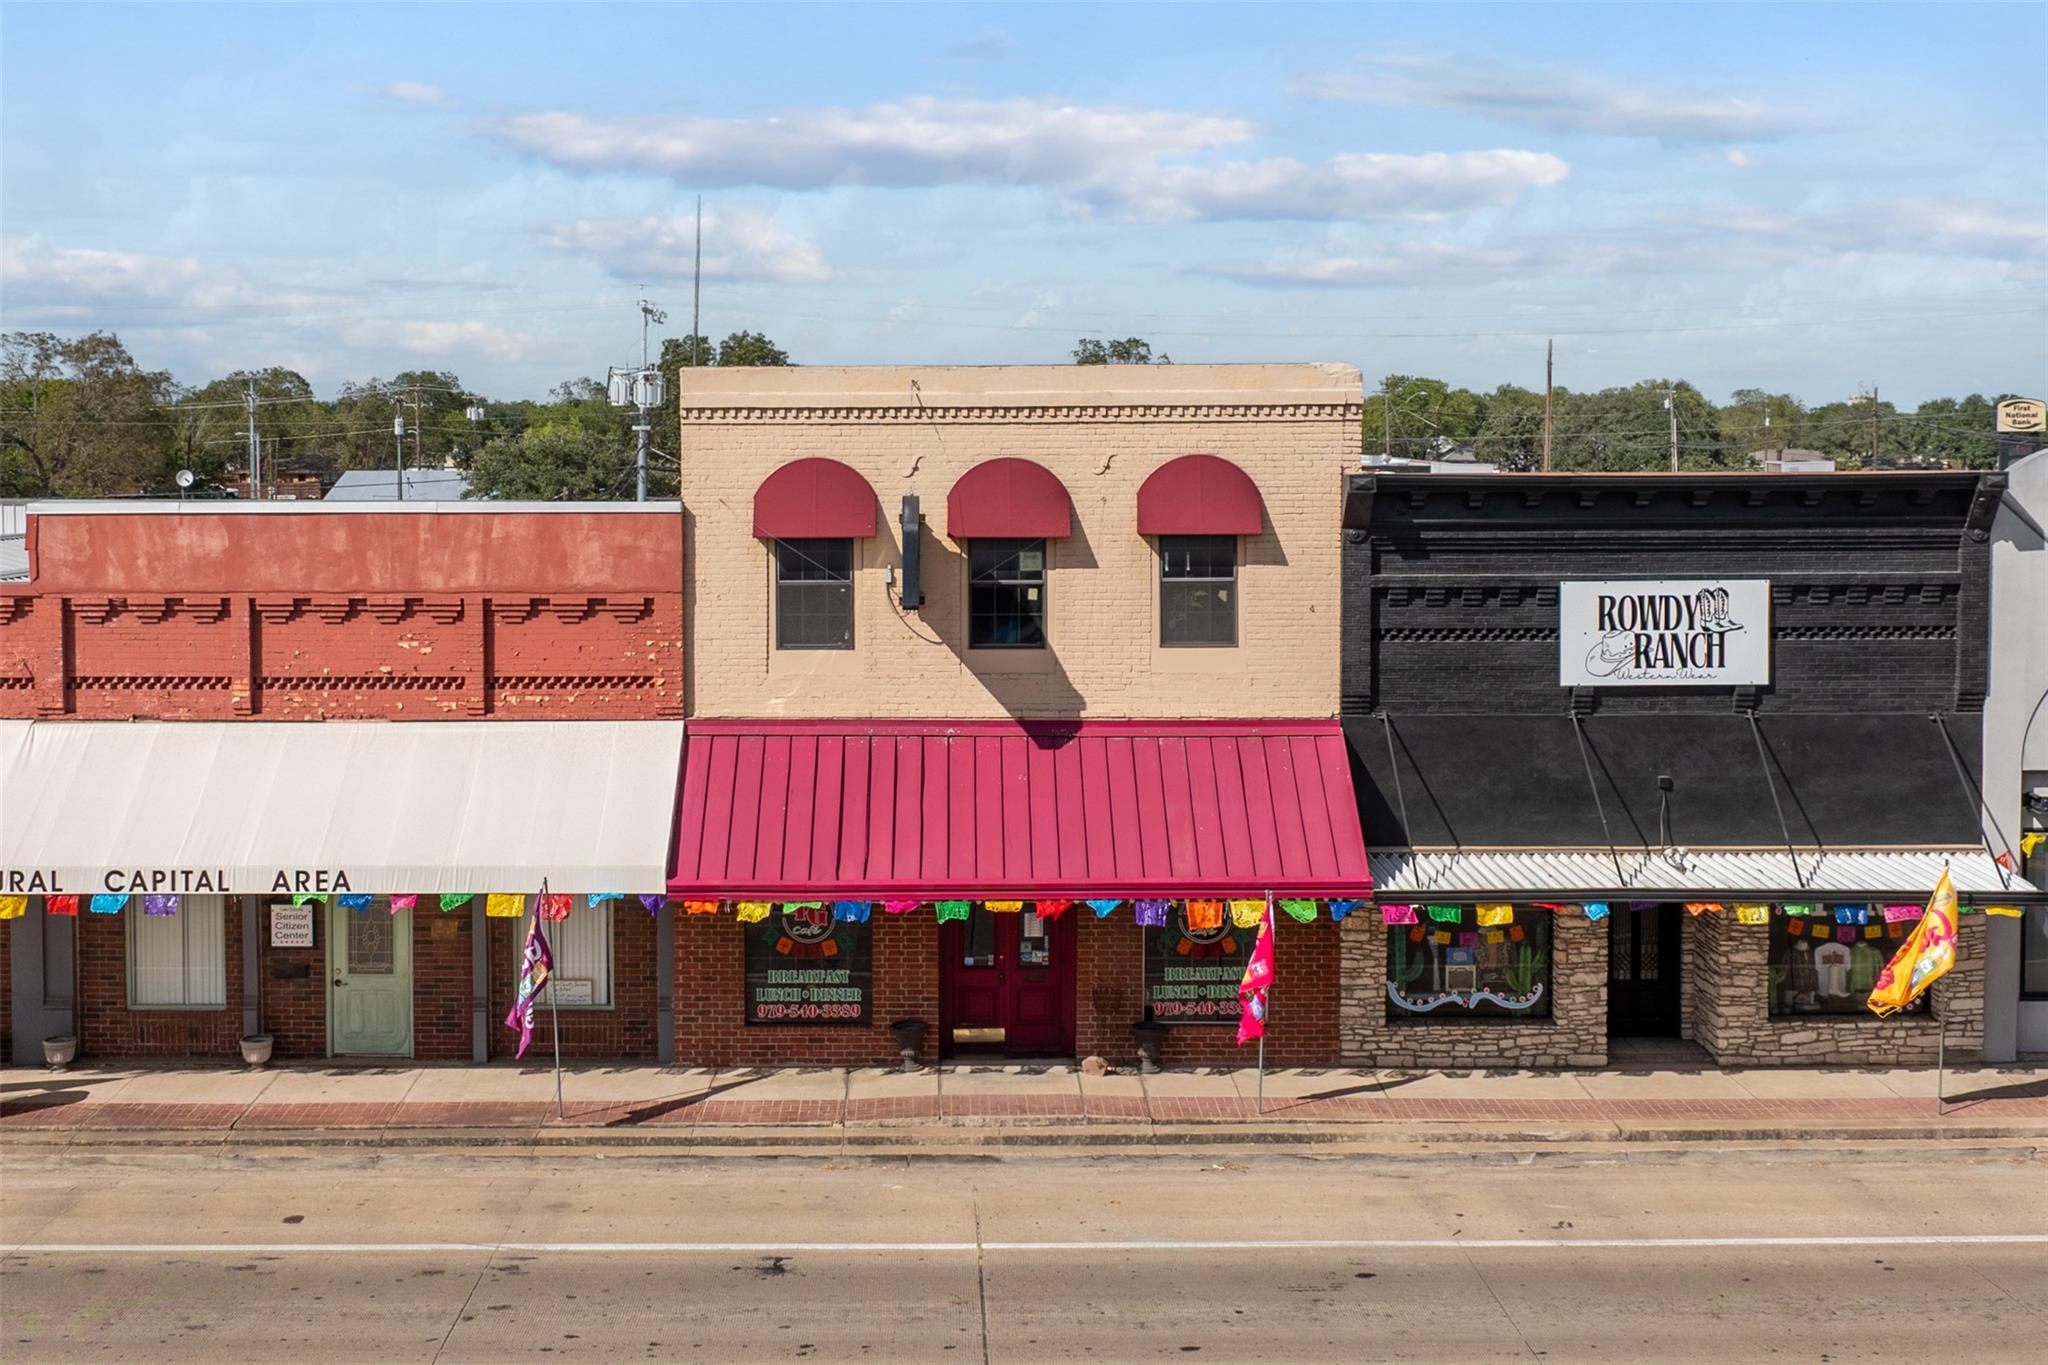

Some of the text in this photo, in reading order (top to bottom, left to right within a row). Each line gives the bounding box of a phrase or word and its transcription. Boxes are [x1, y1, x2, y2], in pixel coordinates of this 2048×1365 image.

[1598, 595, 1702, 631] ROWDY
[1634, 632, 1726, 669] RANCH
[1614, 668, 1717, 680] Western Wear
[0, 870, 351, 892] RAL CAPITAL AREA
[275, 912, 308, 921] Senior
[274, 921, 310, 930] Citizen
[274, 931, 309, 939] Center
[767, 969, 850, 984] BREAKFAST
[757, 1004, 861, 1018] 979-540-3389
[1153, 1001, 1243, 1015] 979-540-33
